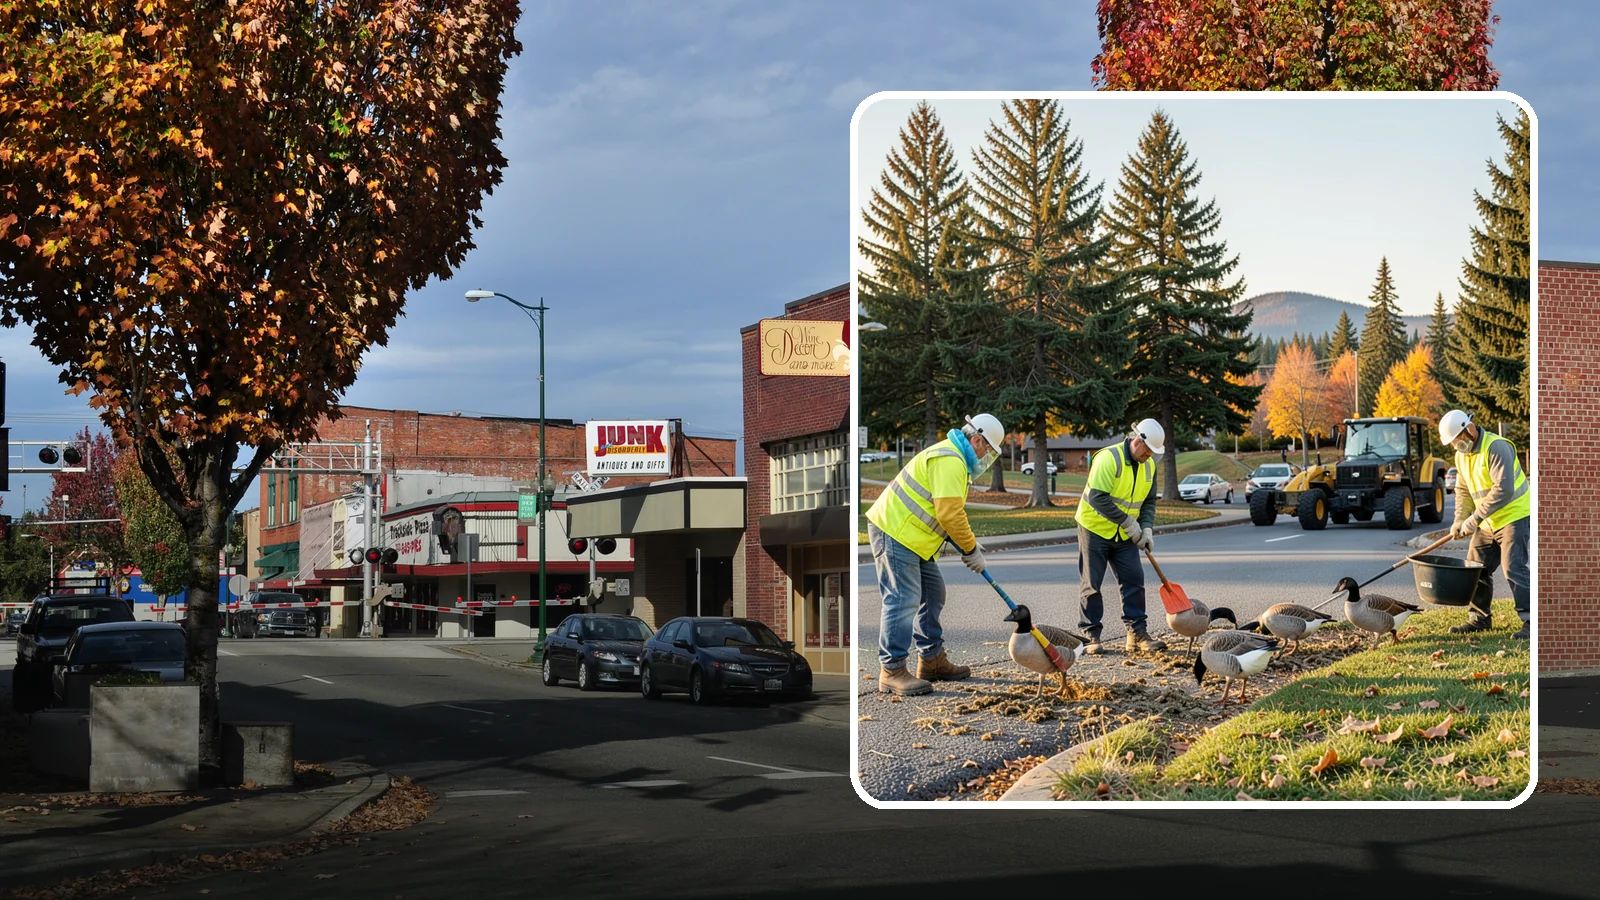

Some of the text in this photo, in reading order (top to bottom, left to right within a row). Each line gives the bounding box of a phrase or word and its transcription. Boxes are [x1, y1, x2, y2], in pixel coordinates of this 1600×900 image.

[596, 425, 665, 457] JUNK
[607, 446, 646, 454] DISORDERLY
[596, 460, 666, 470] ANTIQUES AND GIFTS
[390, 519, 429, 539] Trackside Pizza
